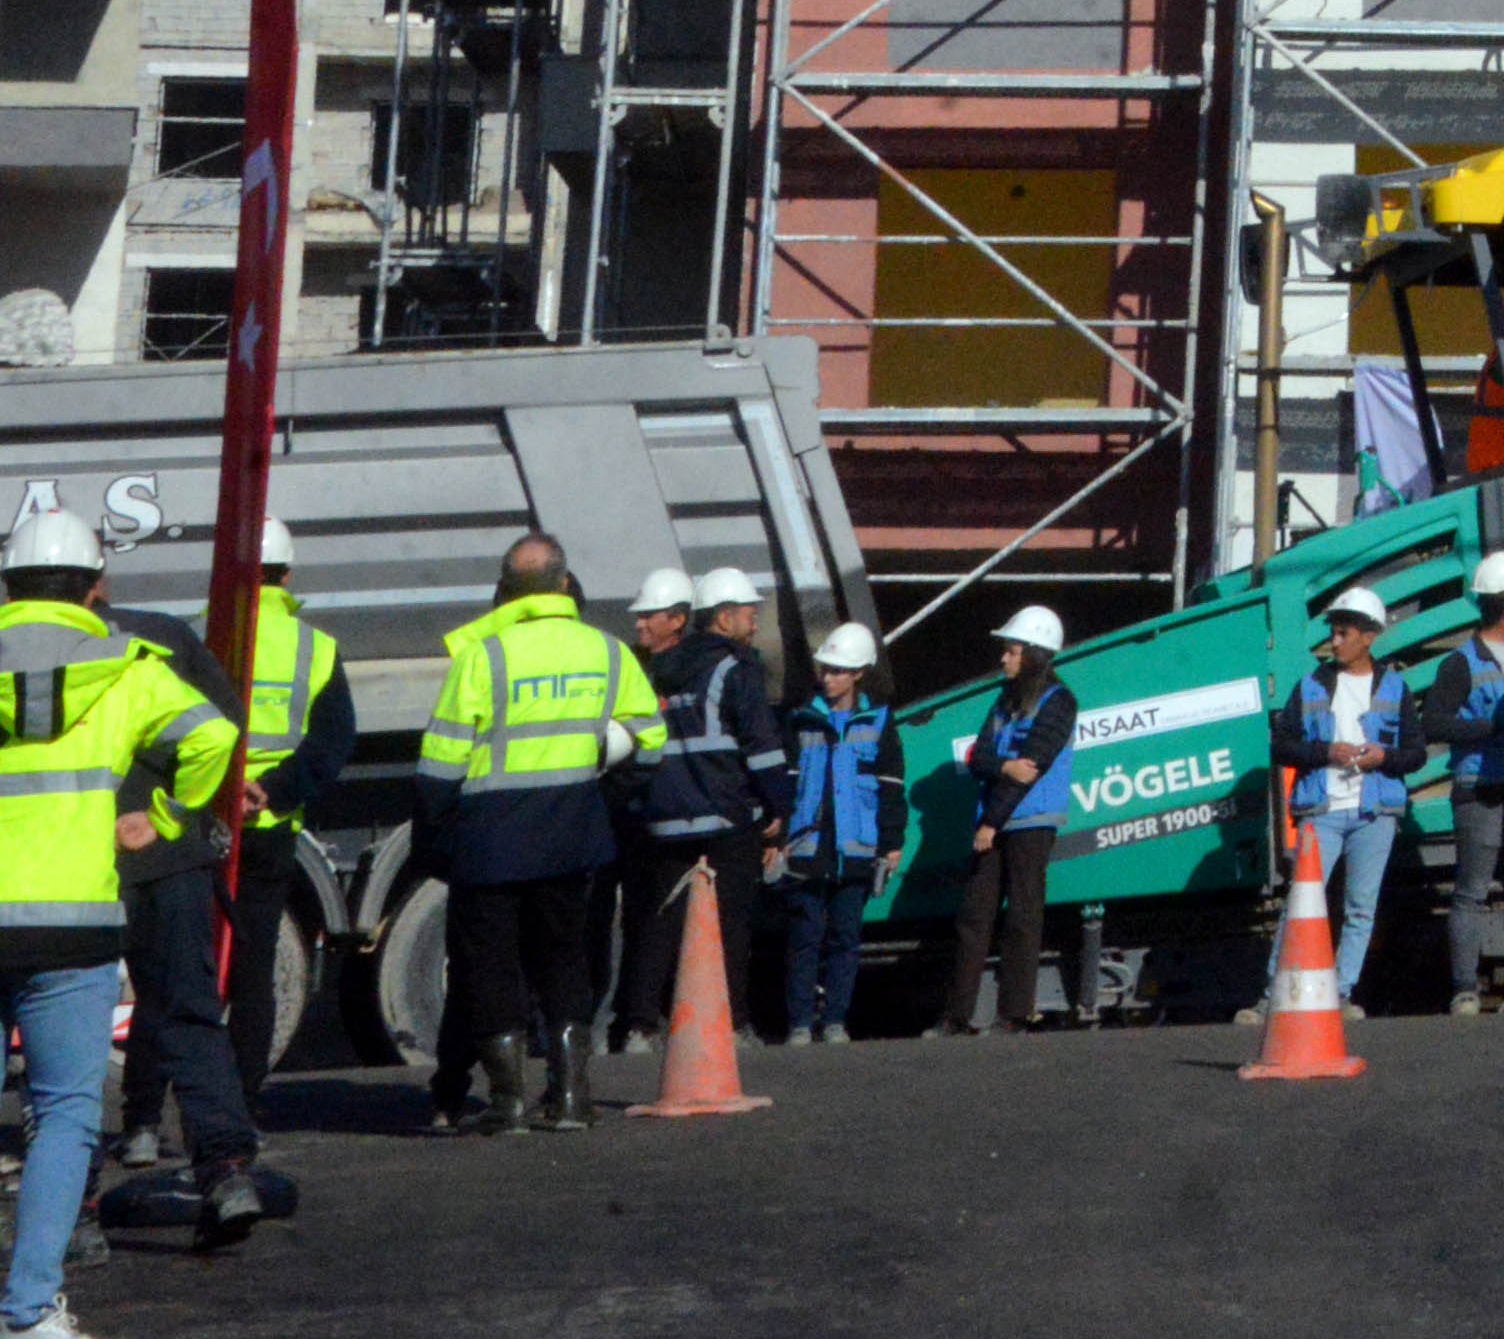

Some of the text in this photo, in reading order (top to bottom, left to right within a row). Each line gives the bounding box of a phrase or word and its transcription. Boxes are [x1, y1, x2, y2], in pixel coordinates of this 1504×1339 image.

[1078, 707, 1161, 742] NŞAAT
[1072, 748, 1234, 812] VÖGELE
[1096, 817, 1158, 849] SUPER
